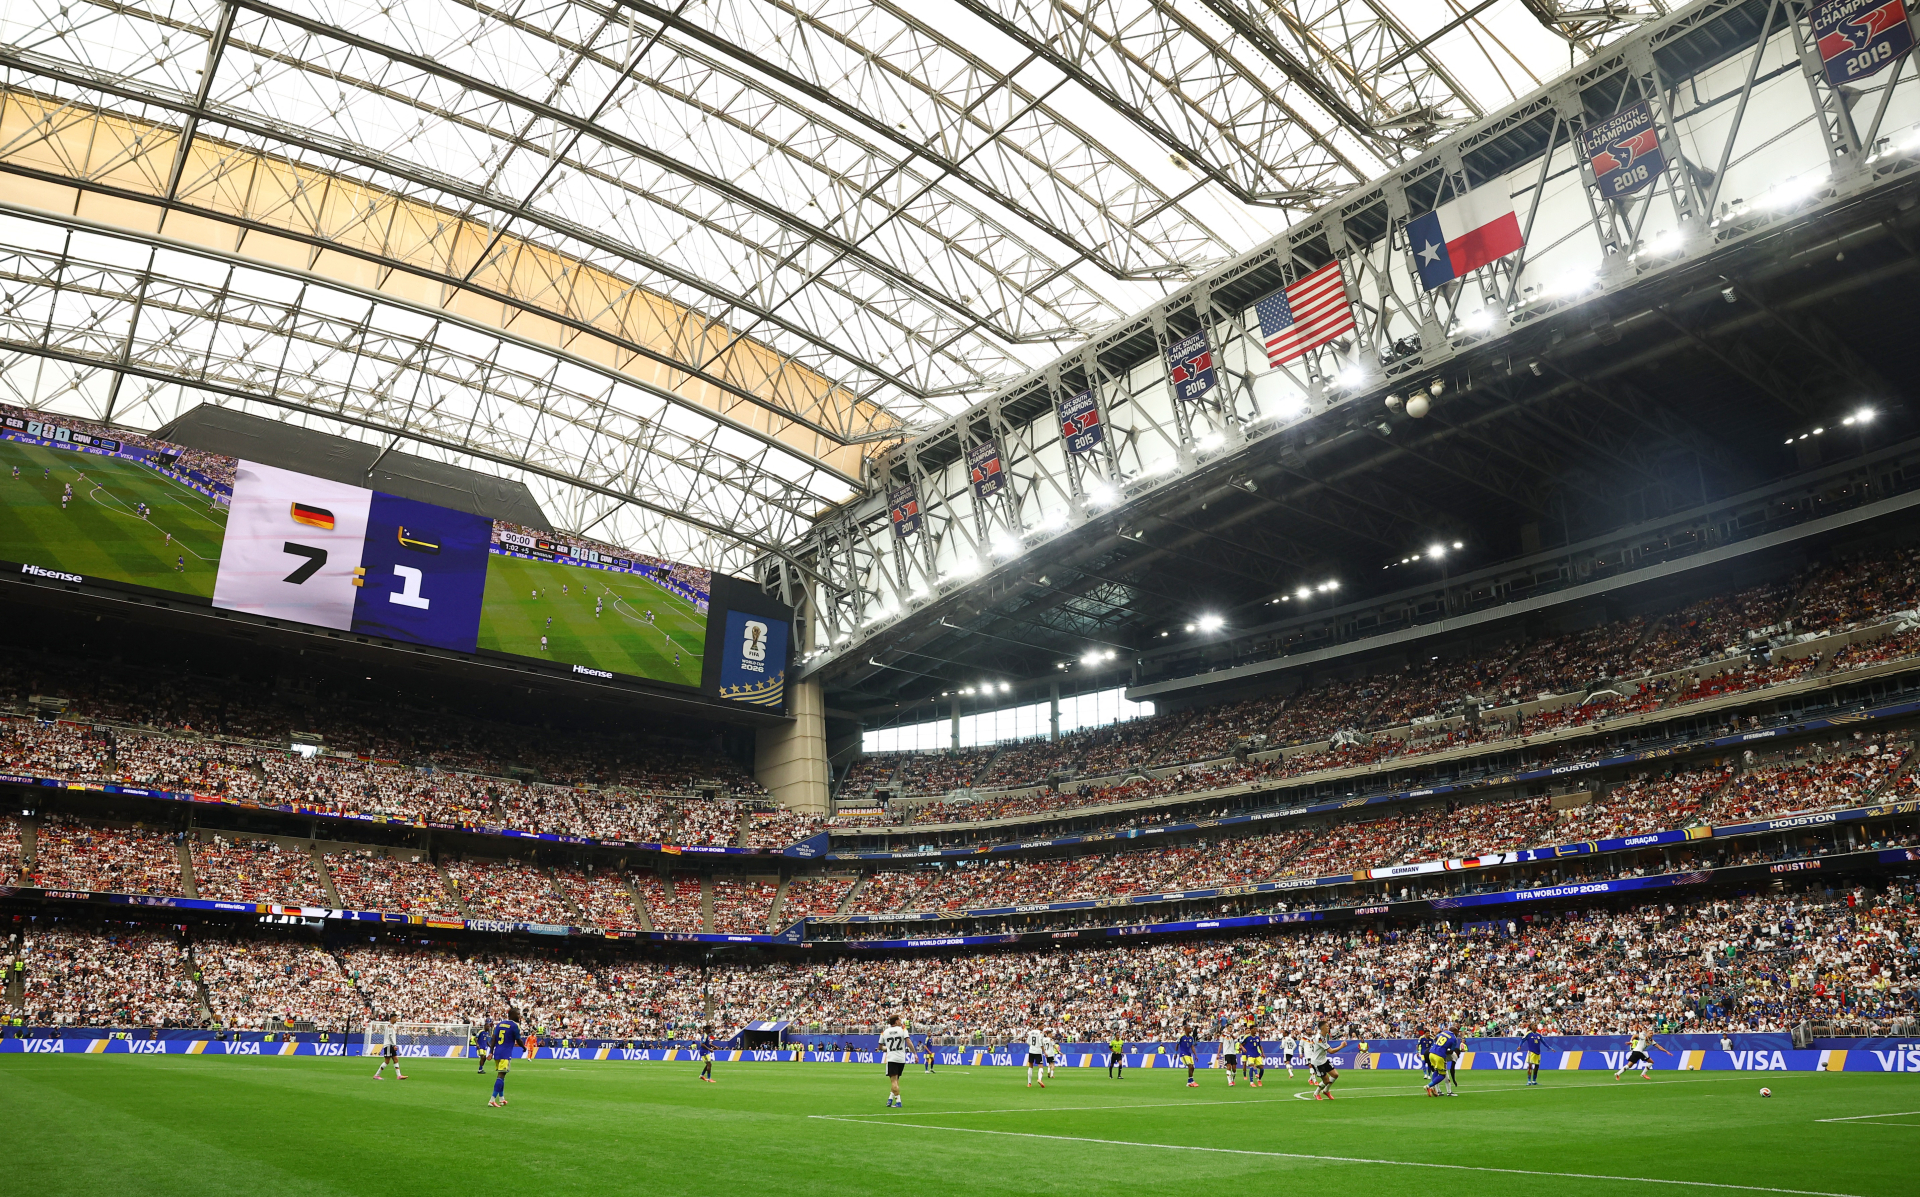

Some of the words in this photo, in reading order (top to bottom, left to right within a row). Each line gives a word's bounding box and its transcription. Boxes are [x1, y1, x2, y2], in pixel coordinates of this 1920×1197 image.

[1846, 41, 1892, 76] 2019
[1592, 125, 1608, 138] AFC
[1610, 108, 1639, 128] SOUTH
[1588, 113, 1648, 150] CHAMPIONS
[1614, 165, 1648, 192] 2018
[1170, 340, 1205, 362] CHAMPIONS
[1172, 344, 1182, 353] AFC
[1183, 335, 1200, 349] SOUTH
[1186, 378, 1206, 396] 2016
[1061, 399, 1092, 418] CHAMPIONS
[1064, 402, 1072, 410] AFC
[1072, 394, 1087, 406] SOUTH
[6, 418, 24, 428] GER
[72, 433, 92, 444] CUW
[1075, 433, 1094, 450] 2015
[970, 449, 996, 465] CHAMPIONS
[981, 480, 997, 494] 2012
[902, 521, 913, 533] 2011
[505, 533, 530, 545] 90:00
[556, 545, 568, 553] GER
[600, 554, 612, 563] CUW
[282, 542, 328, 584] 7
[22, 564, 82, 582] Hisense
[389, 564, 430, 610] 1
[573, 664, 613, 679] Hisense
[741, 663, 764, 673] 2026
[1552, 761, 1599, 775] HOUSTON
[1769, 813, 1836, 828] HOUSTON
[1625, 835, 1658, 846] CURAÇAO
[1498, 854, 1507, 864] 7
[1527, 850, 1537, 860] 1
[1392, 866, 1419, 875] GERMANY
[1770, 860, 1821, 874] HOUSTON
[1275, 879, 1316, 888] HOUSTON
[45, 890, 89, 899] HOUSTON
[1516, 891, 1532, 900] FIFA
[1533, 888, 1562, 898] WORLD
[1562, 886, 1579, 895] CUP
[1580, 883, 1608, 893] 2026
[324, 909, 333, 918] 7
[351, 911, 360, 919] 1
[1355, 906, 1389, 915] HOUSTON
[470, 920, 511, 933] KETSCH
[498, 1030, 505, 1045] 5
[887, 1037, 903, 1051] 22
[1032, 1036, 1036, 1046] 8
[1436, 1036, 1447, 1046] 19
[19, 1038, 64, 1052] VISA
[124, 1040, 166, 1053] VISA
[222, 1041, 260, 1055] VISA
[311, 1043, 347, 1056] VISA
[396, 1045, 430, 1057] VISA
[552, 1048, 580, 1059] VISA
[621, 1049, 649, 1060] VISA
[751, 1050, 778, 1061] VISA
[814, 1051, 835, 1063] VISA
[856, 1052, 874, 1063] VISA
[941, 1053, 962, 1065] VISA
[991, 1054, 1012, 1066] VISA
[1724, 1051, 1788, 1070] VISA
[1870, 1051, 1920, 1072] VIS
